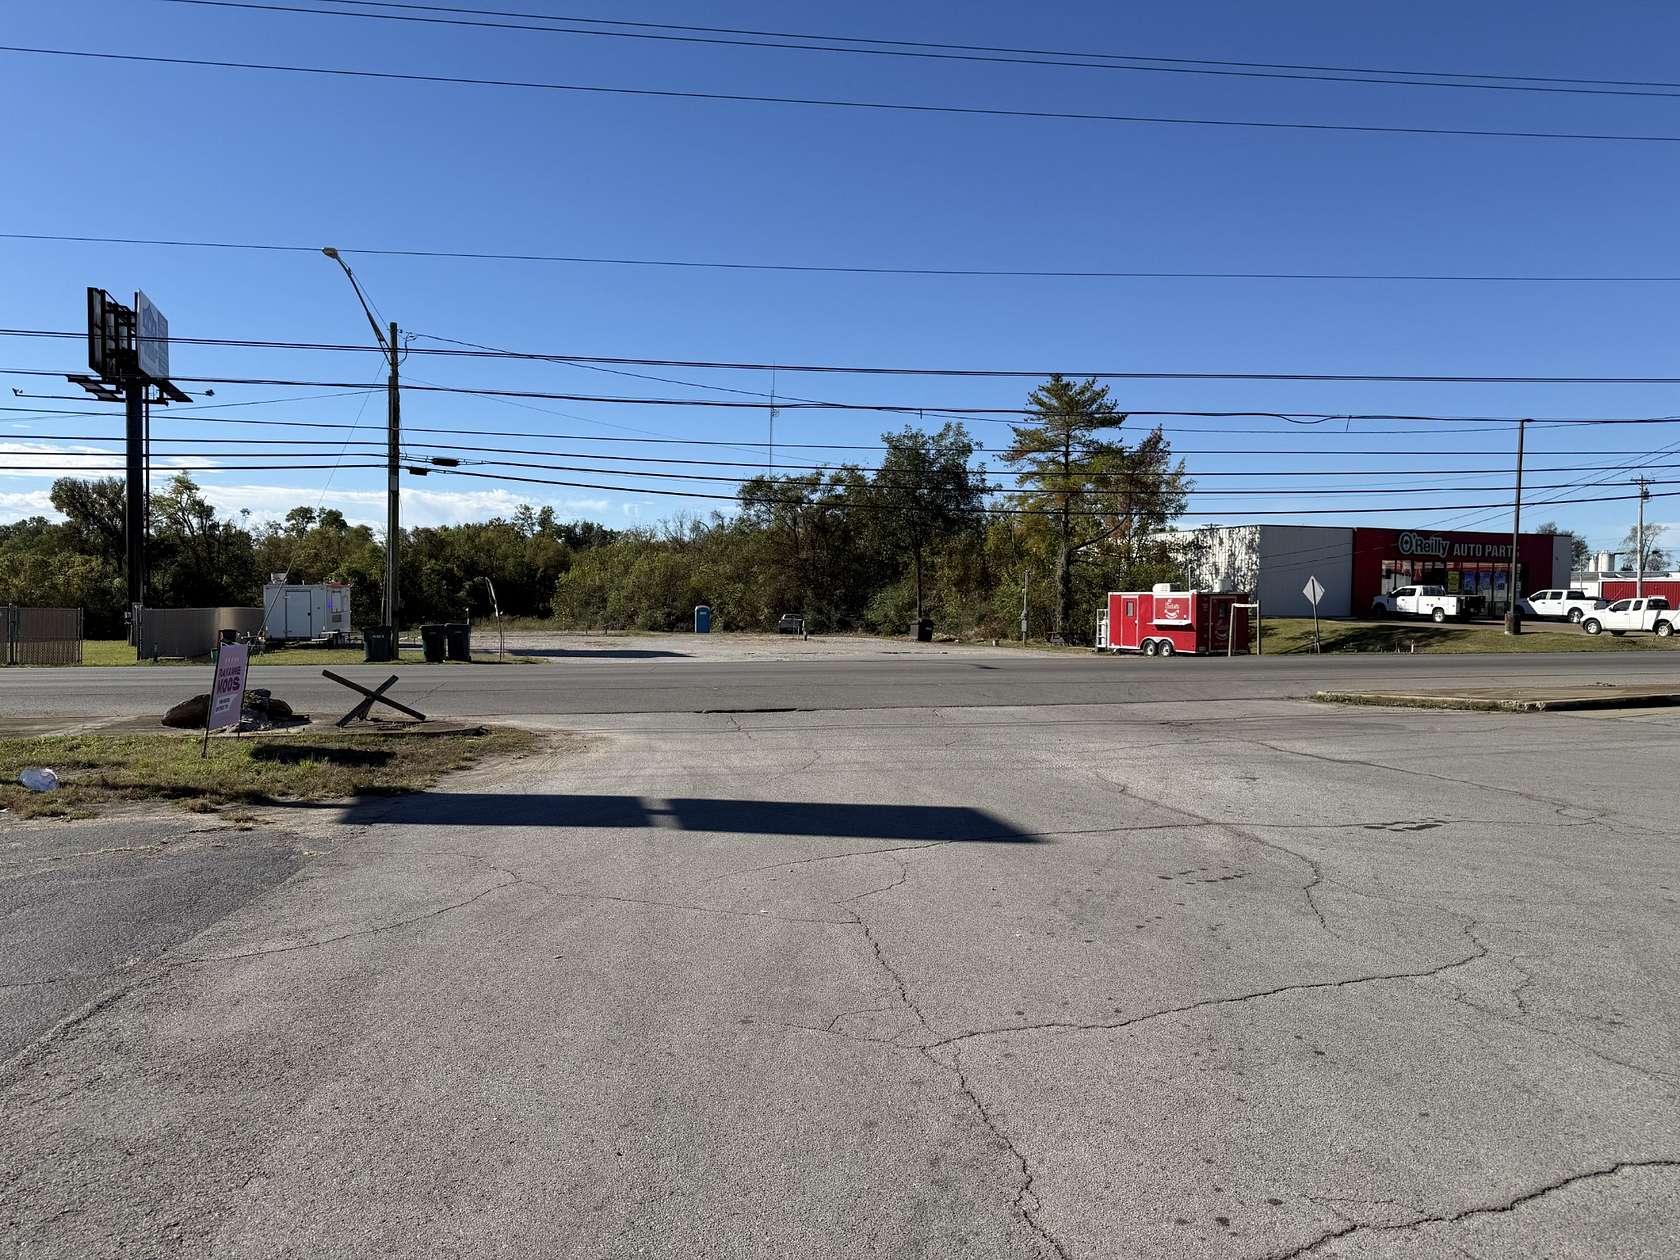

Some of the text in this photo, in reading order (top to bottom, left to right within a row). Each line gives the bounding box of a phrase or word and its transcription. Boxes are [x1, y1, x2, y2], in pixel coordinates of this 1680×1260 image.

[1398, 531, 1519, 558] O'Reilly AUTO PART
